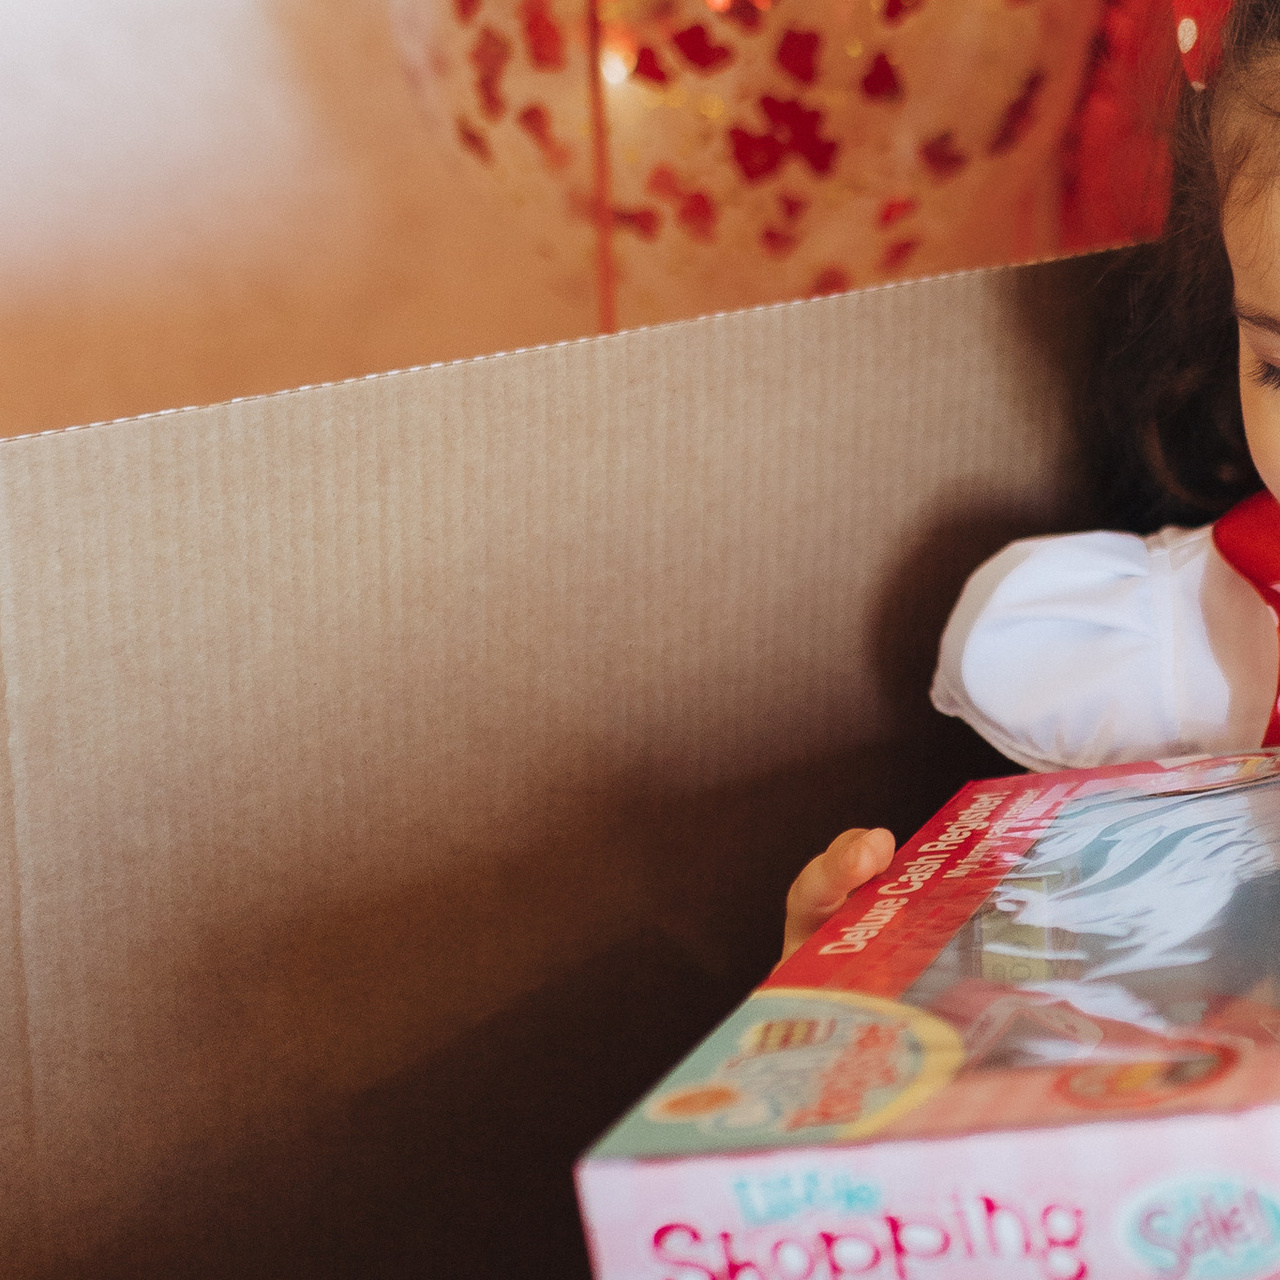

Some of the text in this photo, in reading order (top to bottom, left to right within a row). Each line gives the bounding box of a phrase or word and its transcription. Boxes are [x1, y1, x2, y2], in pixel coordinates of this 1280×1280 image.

[818, 791, 1012, 955] Deluxe Cash Register!
